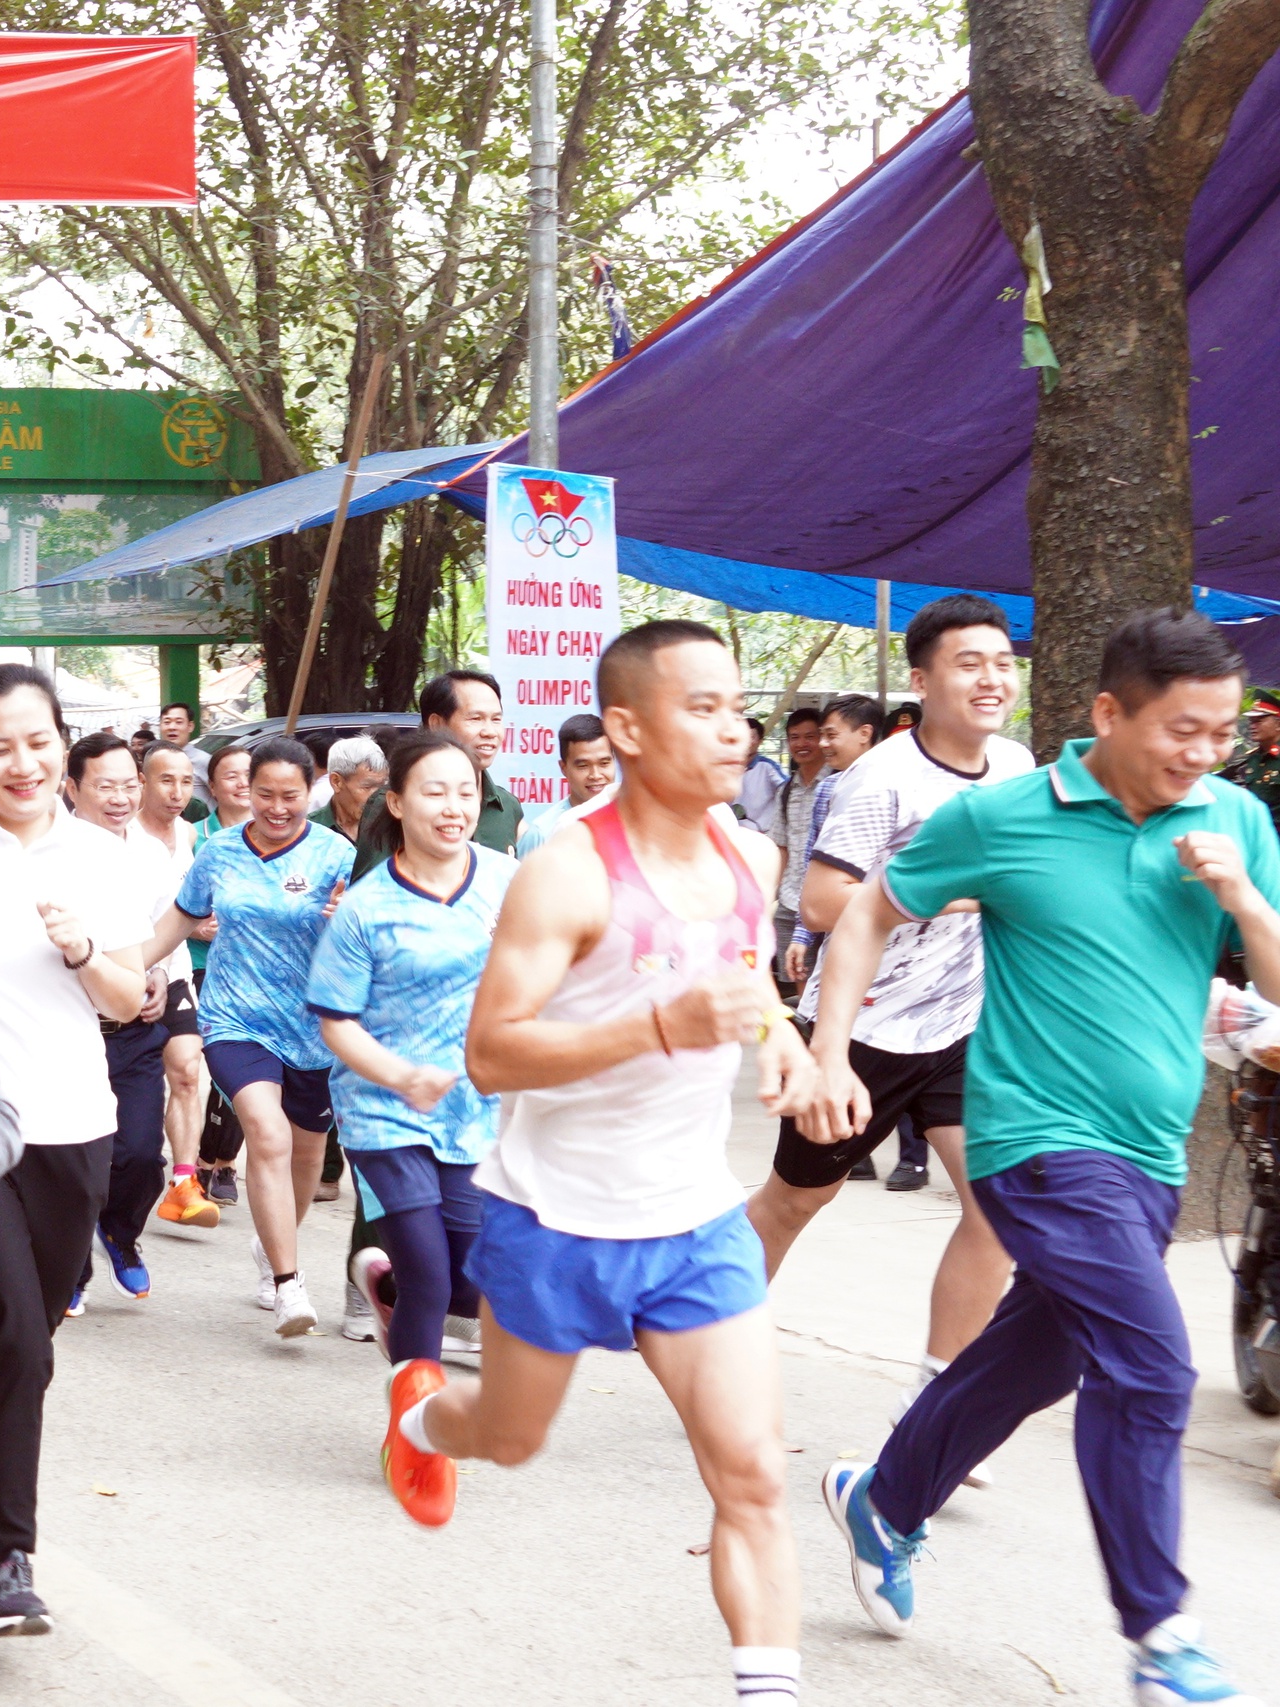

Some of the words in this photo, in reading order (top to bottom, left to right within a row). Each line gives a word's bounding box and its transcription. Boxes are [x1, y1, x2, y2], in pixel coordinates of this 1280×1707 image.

[506, 572, 563, 608] HƯỞNG
[569, 576, 603, 610] ỨNG
[506, 624, 550, 657] NGÀY
[557, 630, 603, 662] CHẠY
[516, 678, 592, 706] OLIMPIC
[520, 723, 555, 755] SỨC
[508, 771, 554, 804] TOÀN
